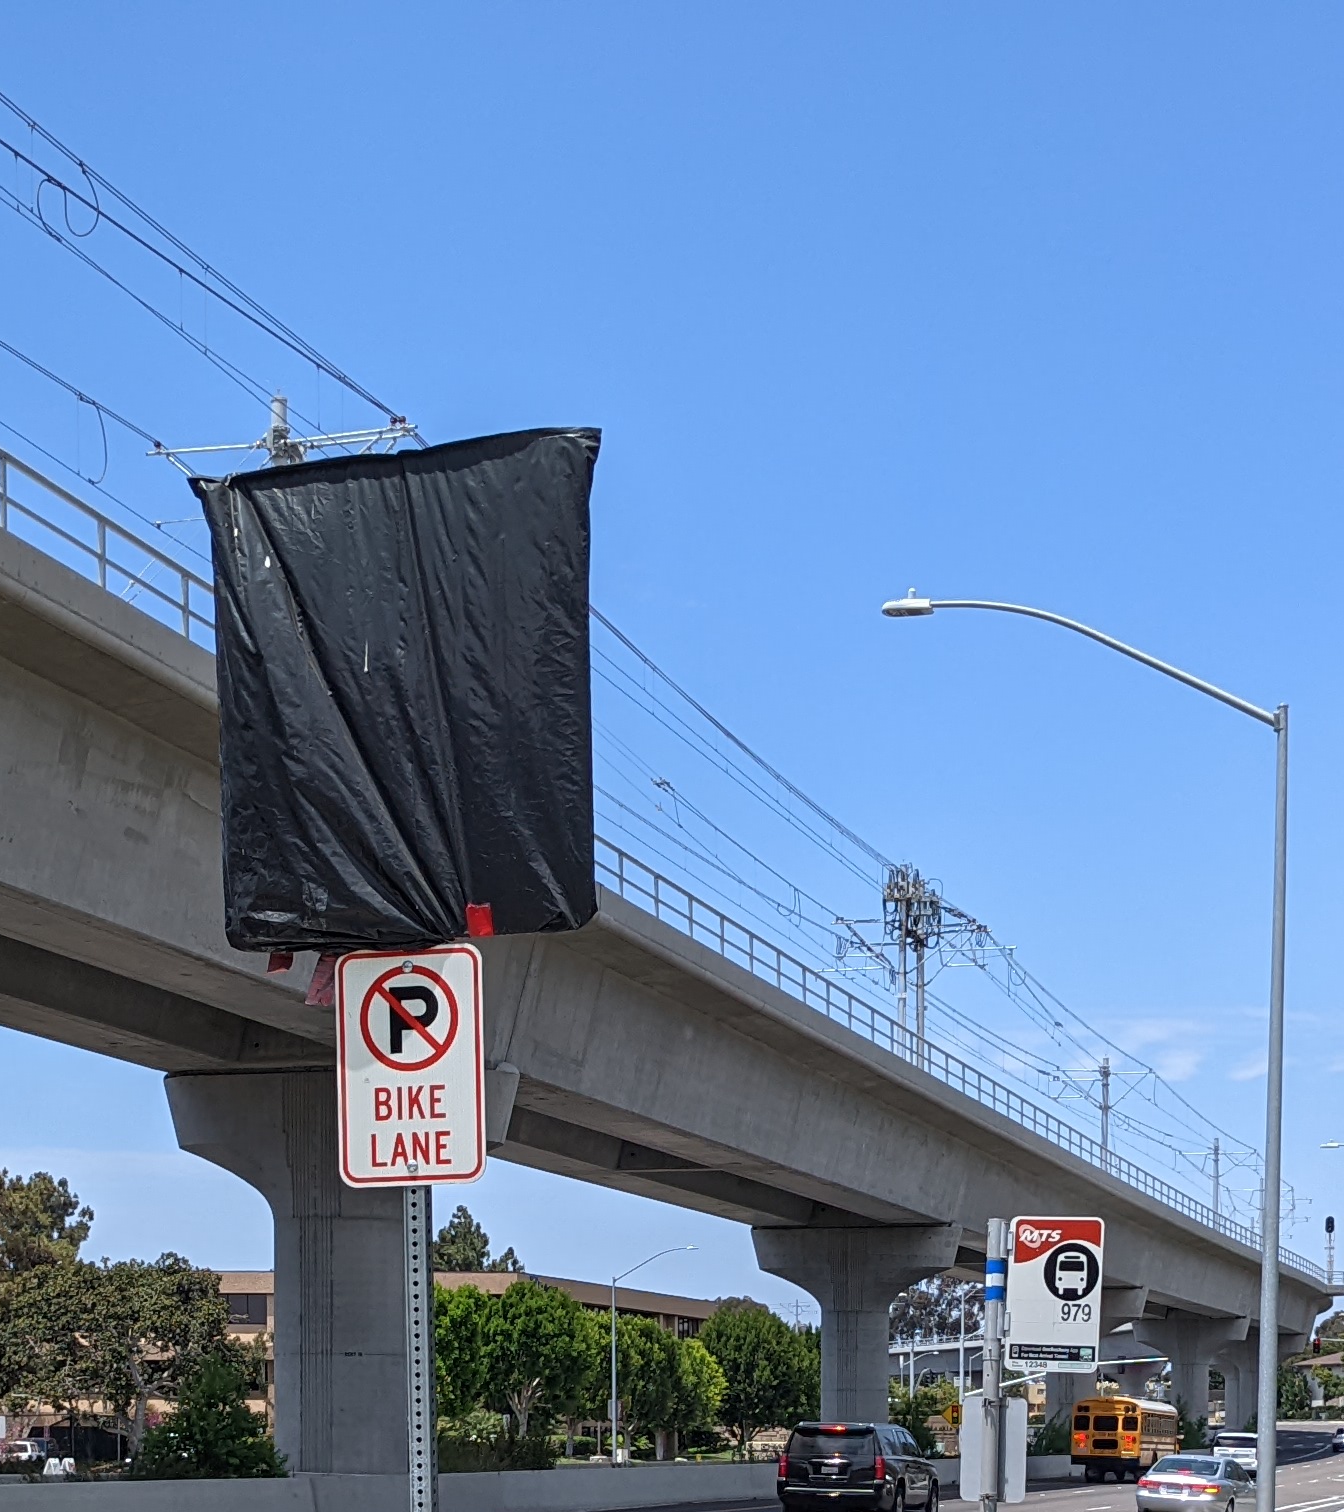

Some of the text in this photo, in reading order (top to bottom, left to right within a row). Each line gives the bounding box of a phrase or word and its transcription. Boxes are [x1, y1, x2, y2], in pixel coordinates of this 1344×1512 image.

[374, 1084, 447, 1122] BIKE
[370, 1130, 452, 1168] LANE
[1018, 1229, 1063, 1242] MTS
[1060, 1302, 1092, 1323] 979
